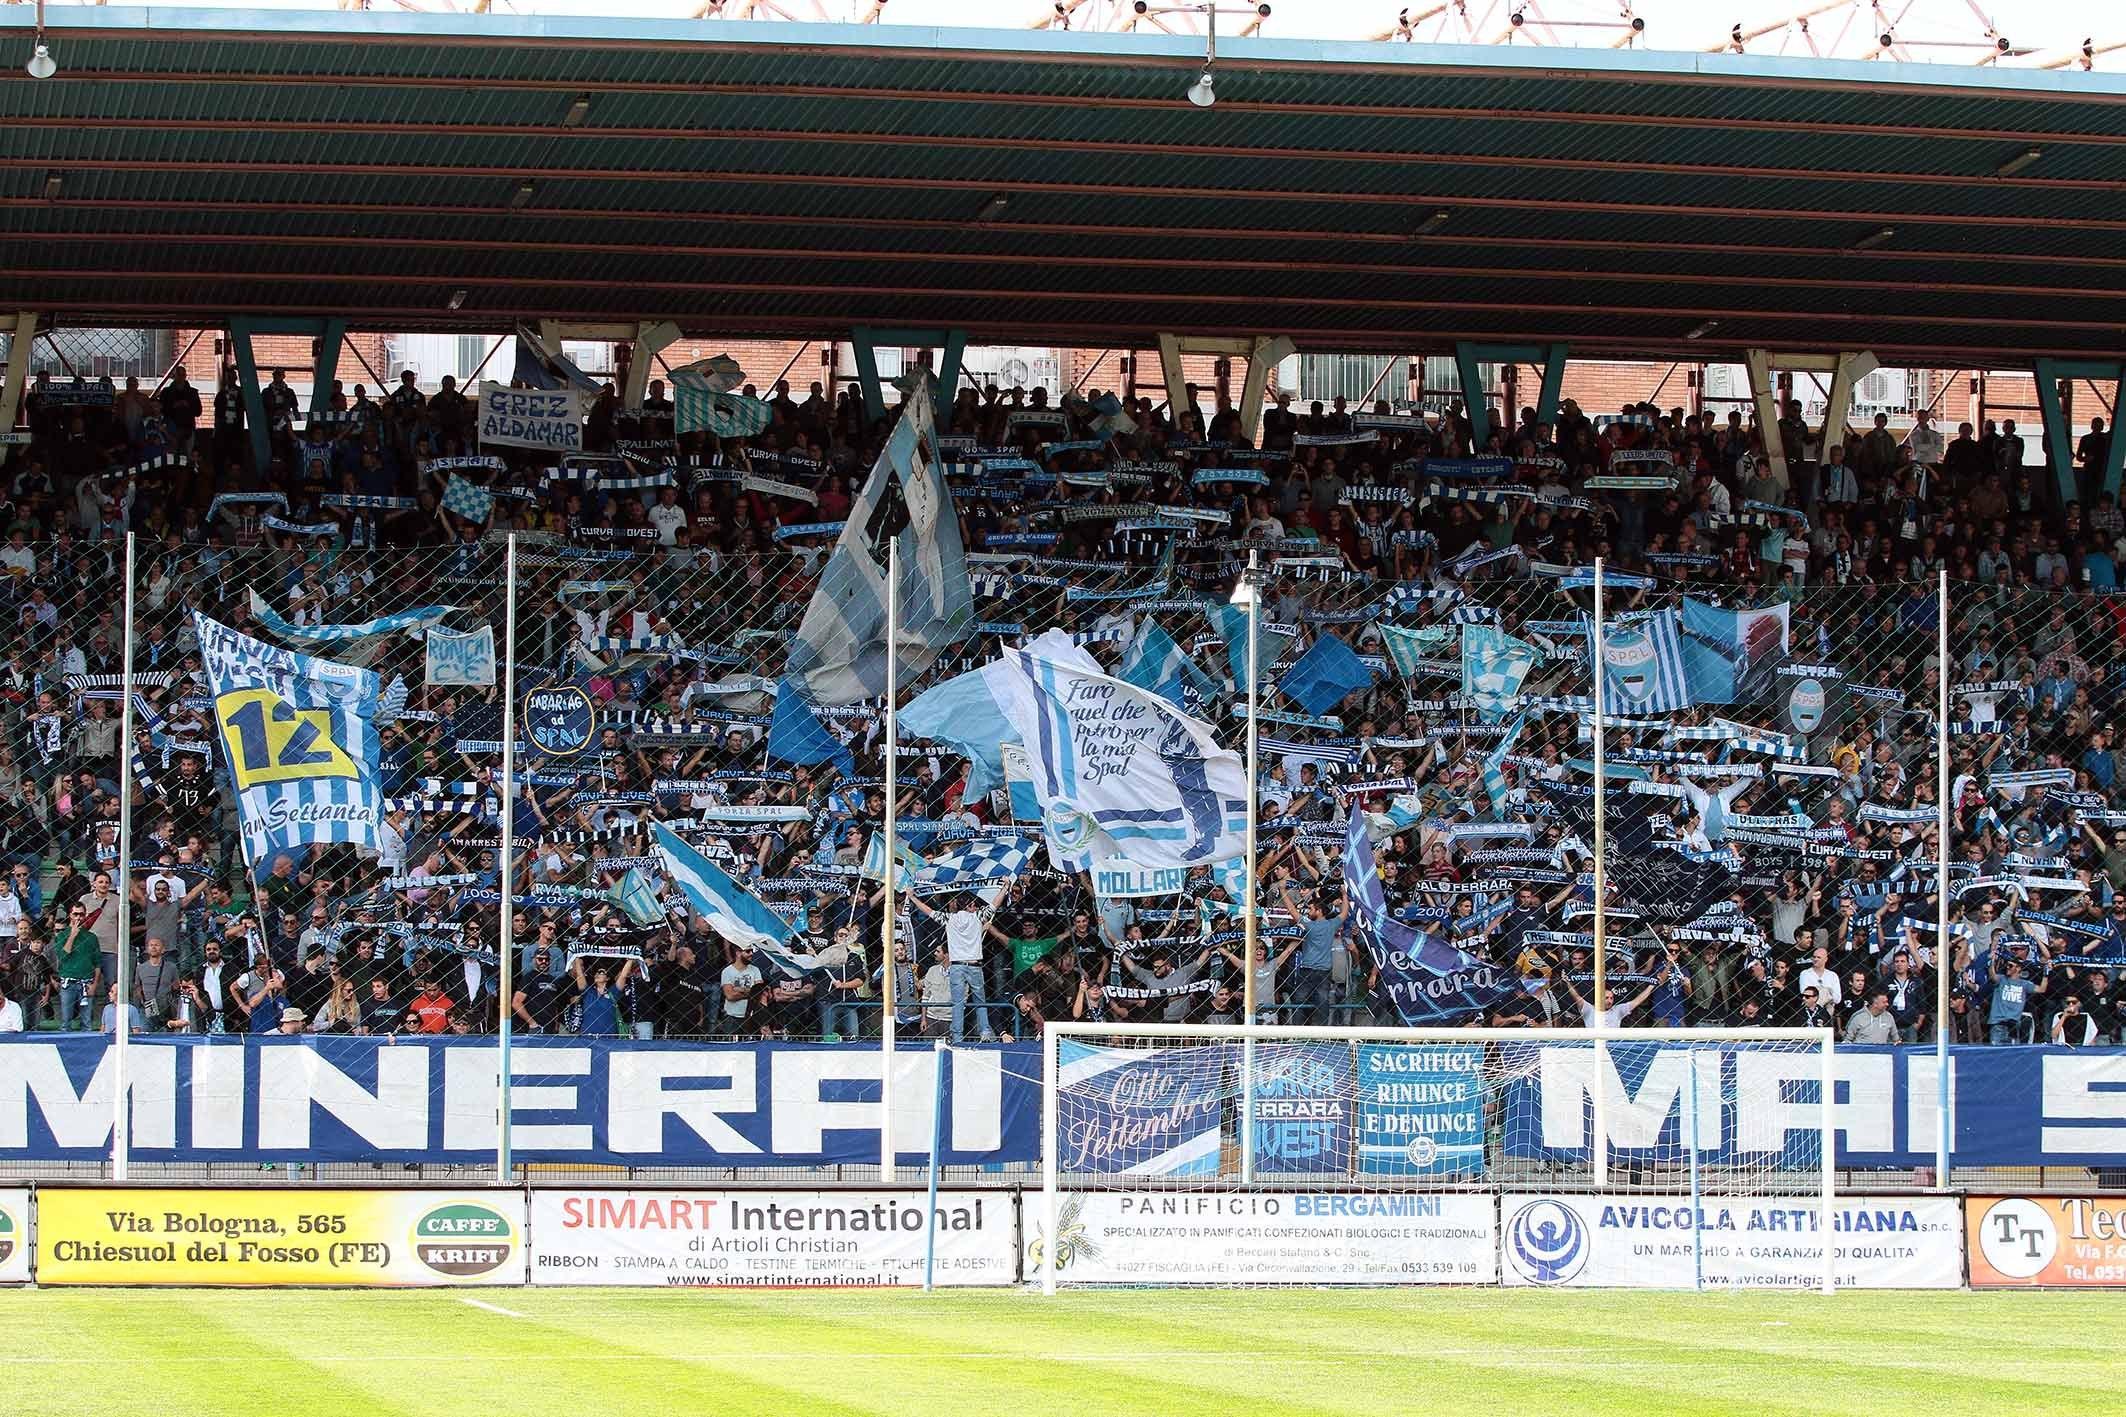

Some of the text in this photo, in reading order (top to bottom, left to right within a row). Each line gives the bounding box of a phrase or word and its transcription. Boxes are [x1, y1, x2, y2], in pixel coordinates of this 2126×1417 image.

[550, 714, 565, 726] ad
[1111, 702, 1147, 721] che
[225, 700, 333, 771] 12
[534, 726, 585, 747] SPAL
[1083, 757, 1131, 785] Spal
[718, 806, 783, 816] FORZA SPAL
[1810, 843, 1894, 860] CURVA OVEST
[1453, 879, 1512, 891] FERRARA
[0, 1044, 1002, 1154] MINERAI
[1540, 1047, 1956, 1153] MAI
[1377, 1082, 1467, 1103] RINUNCE
[1365, 1112, 1477, 1134] E DENUNCE
[561, 1197, 983, 1232] SIMART International
[1120, 1195, 1442, 1217] PANIFICIO BERGAMINI
[106, 1212, 347, 1238] Via Bologna, 565
[1599, 1205, 1736, 1231] AVICOLA
[1103, 1226, 1187, 1238] SPECIALIZZATO
[1189, 1226, 1200, 1238] IN
[1264, 1226, 1343, 1239] CONFEZIONATI
[1414, 1227, 1488, 1239] TRADIZIONALI
[53, 1240, 392, 1268] Chiesuol del Fosso (FE)
[688, 1235, 859, 1254] di Artioli Christian
[1632, 1244, 1654, 1256] UN
[537, 1255, 599, 1268] RIBBON
[614, 1256, 666, 1269] STAMPA
[685, 1257, 729, 1271] CALDO
[746, 1258, 797, 1271] TESTINE
[805, 1258, 866, 1271] TERMICHE
[882, 1257, 949, 1270] ETICHETE
[667, 1273, 900, 1286] www.simartinternational.it
